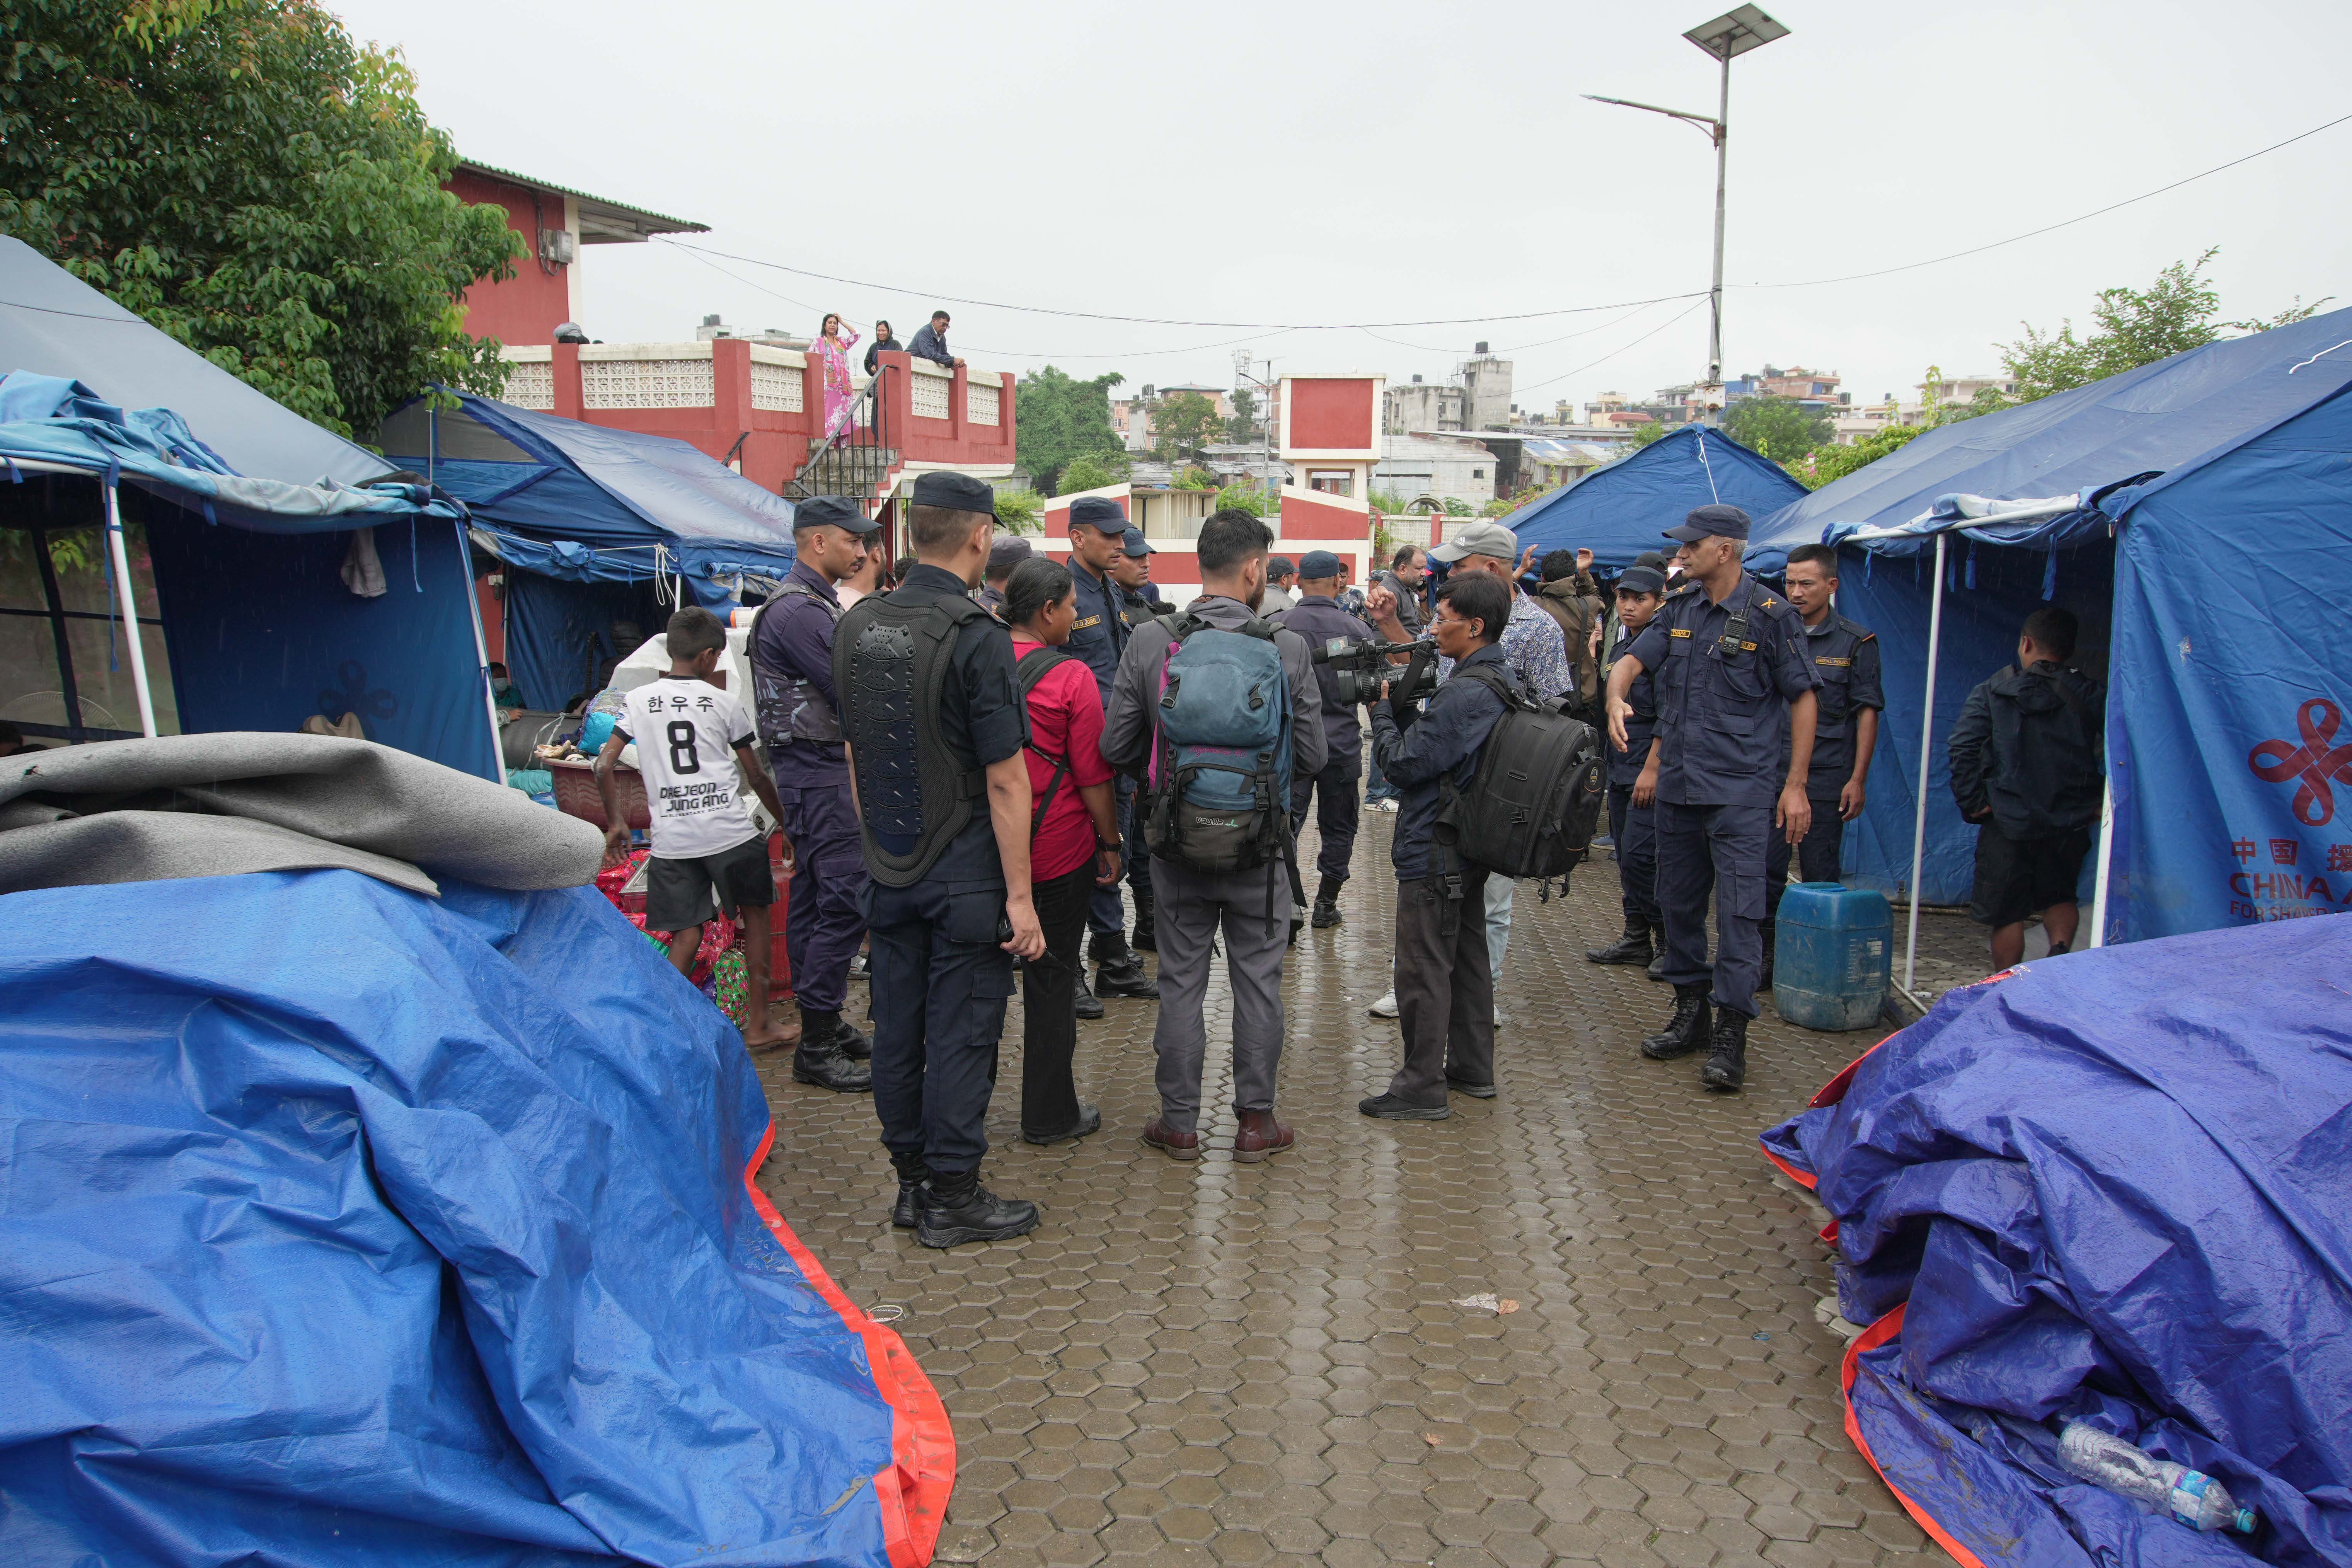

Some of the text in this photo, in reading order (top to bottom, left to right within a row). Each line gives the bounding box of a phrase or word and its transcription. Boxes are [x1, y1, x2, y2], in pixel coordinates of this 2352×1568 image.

[667, 721, 700, 775] 8
[659, 782, 717, 799] DAEJEON
[2229, 872, 2335, 902] CHINA
[2230, 900, 2266, 922] FOR
